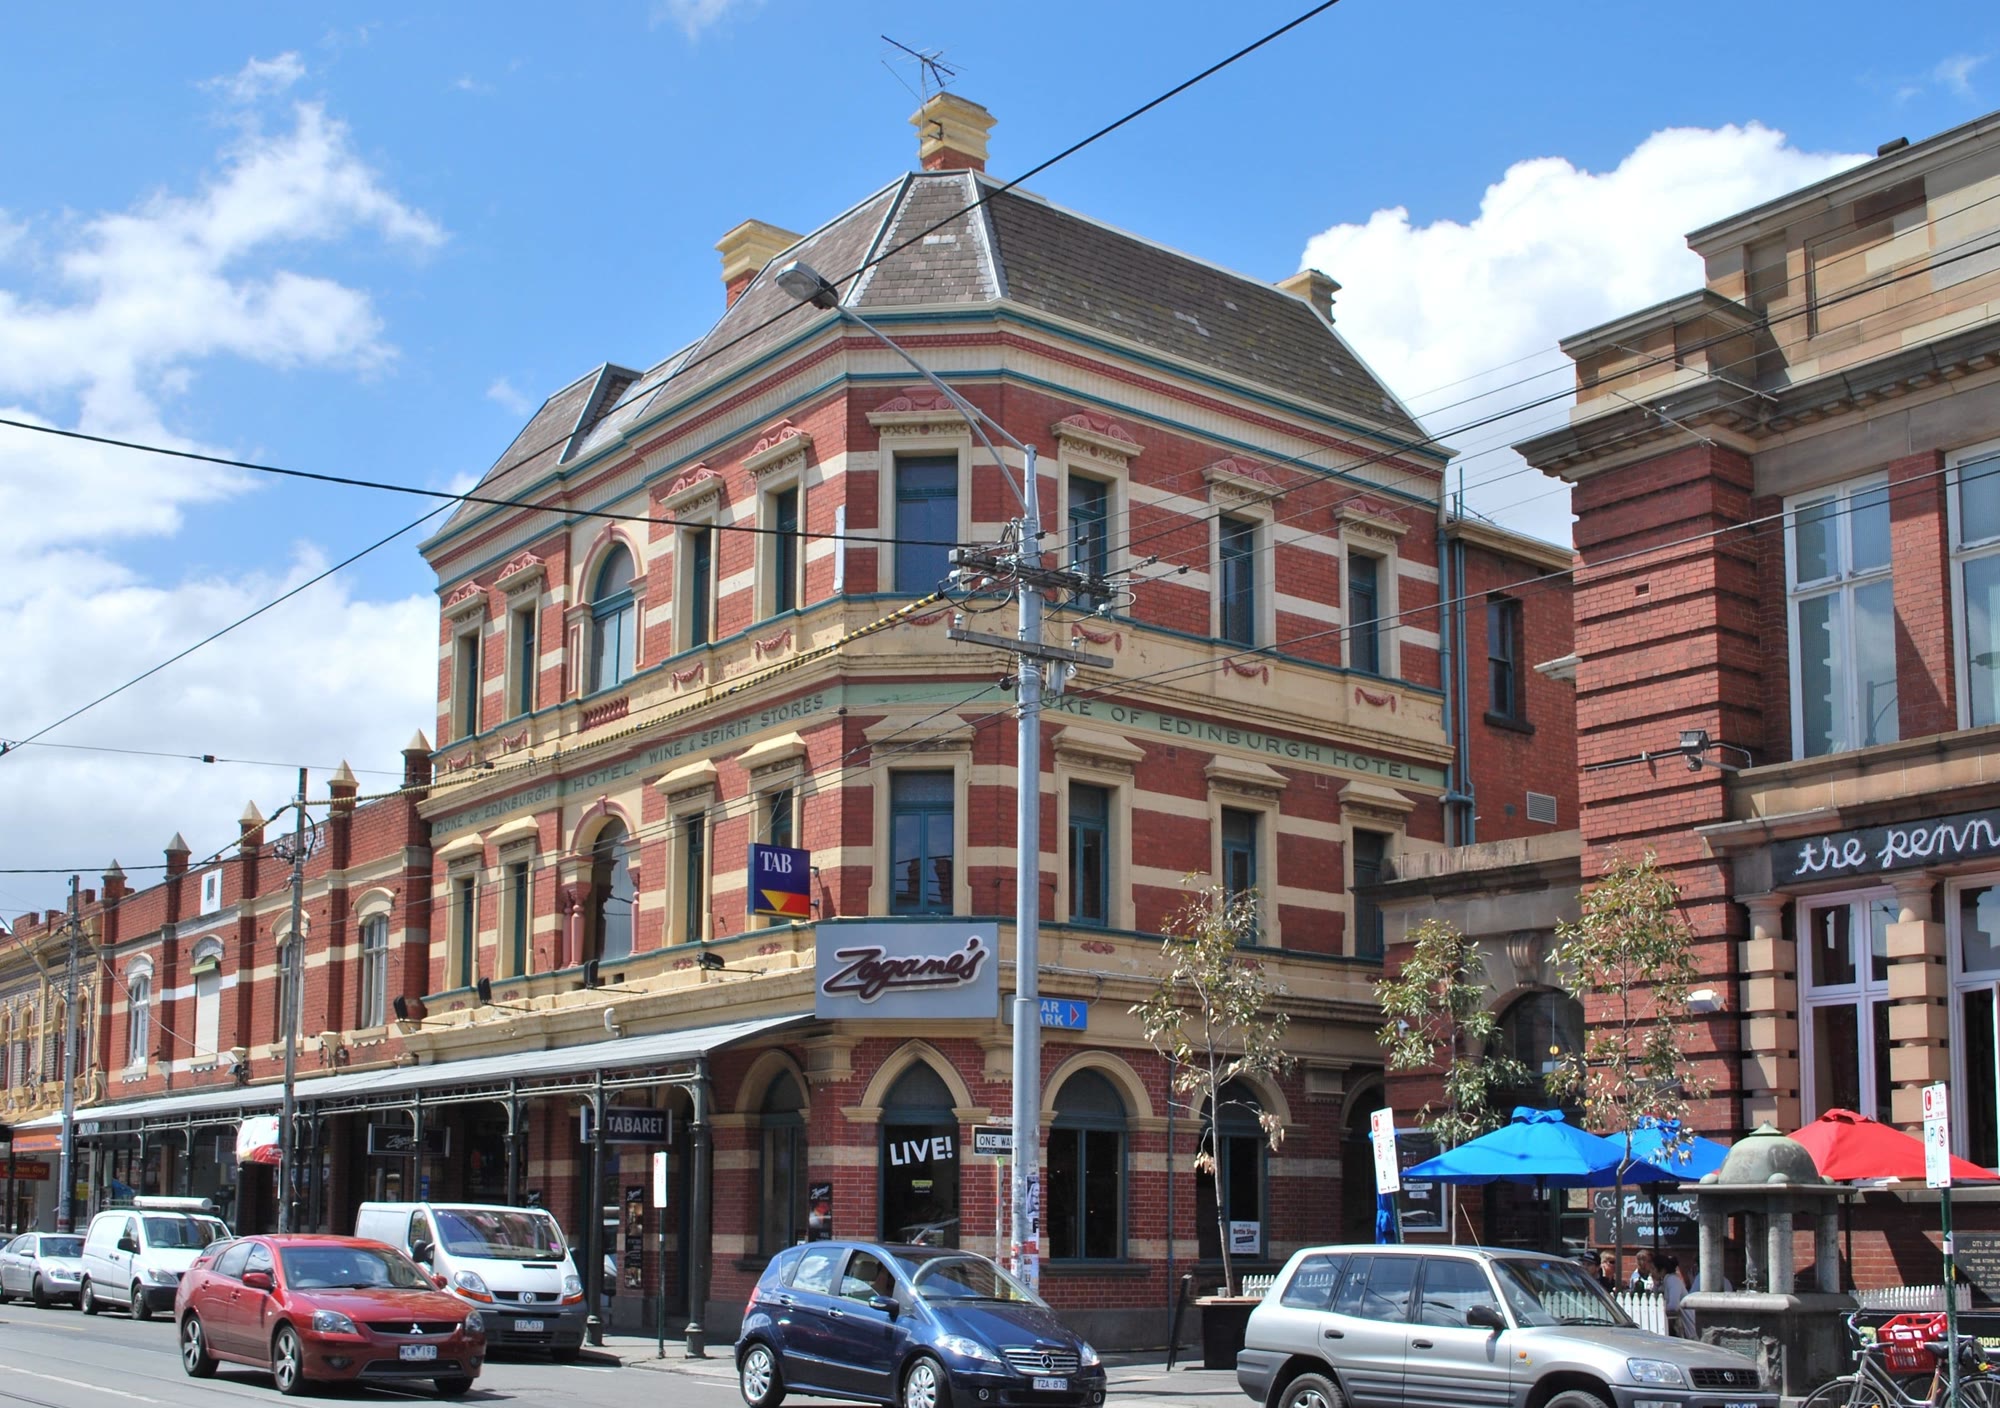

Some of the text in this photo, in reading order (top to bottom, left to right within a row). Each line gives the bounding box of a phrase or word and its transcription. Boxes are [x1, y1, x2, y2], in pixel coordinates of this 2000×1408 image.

[1111, 707, 1142, 724] OF
[1159, 716, 1320, 761] EDINBURGH
[1333, 750, 1420, 782] HOTEL
[437, 694, 824, 834] DUKE OF EDINBURGH HOTEL WINE & SPIRIT STORES
[760, 851, 793, 874] TAB
[1793, 836, 1867, 876] the
[823, 937, 987, 1001] Zagame's
[1041, 1000, 1060, 1013] AR
[1039, 1013, 1064, 1026] ARK
[607, 1116, 664, 1134] TABARET
[890, 1136, 953, 1166] LIVE!
[979, 1136, 997, 1146] ONE
[1623, 1194, 1692, 1218] Funtions
[1977, 1336, 2000, 1348] appr
